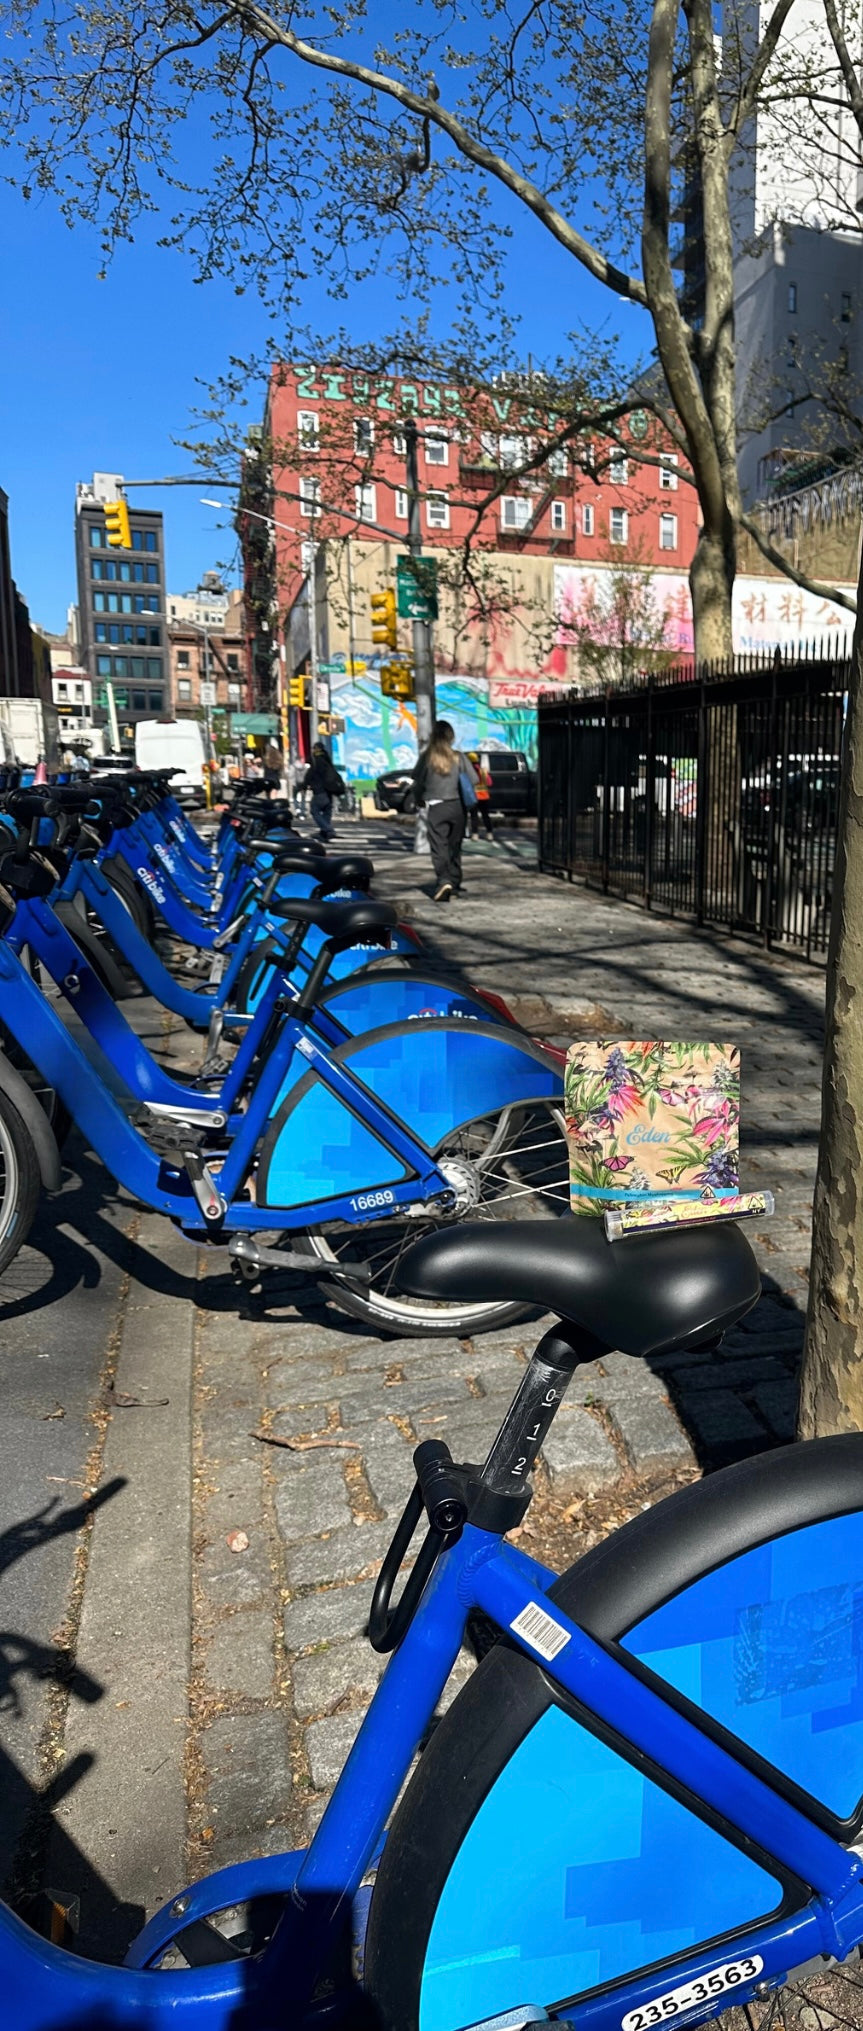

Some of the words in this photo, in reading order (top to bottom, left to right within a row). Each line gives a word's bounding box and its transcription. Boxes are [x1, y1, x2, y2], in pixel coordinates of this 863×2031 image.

[137, 867, 156, 886] citi
[147, 881, 166, 904] bike
[626, 1123, 670, 1146] Eden
[350, 1190, 394, 1211] 16689
[545, 1388, 557, 1402] 0
[514, 1457, 527, 1470] 2
[629, 1959, 757, 2031] 235-3563
